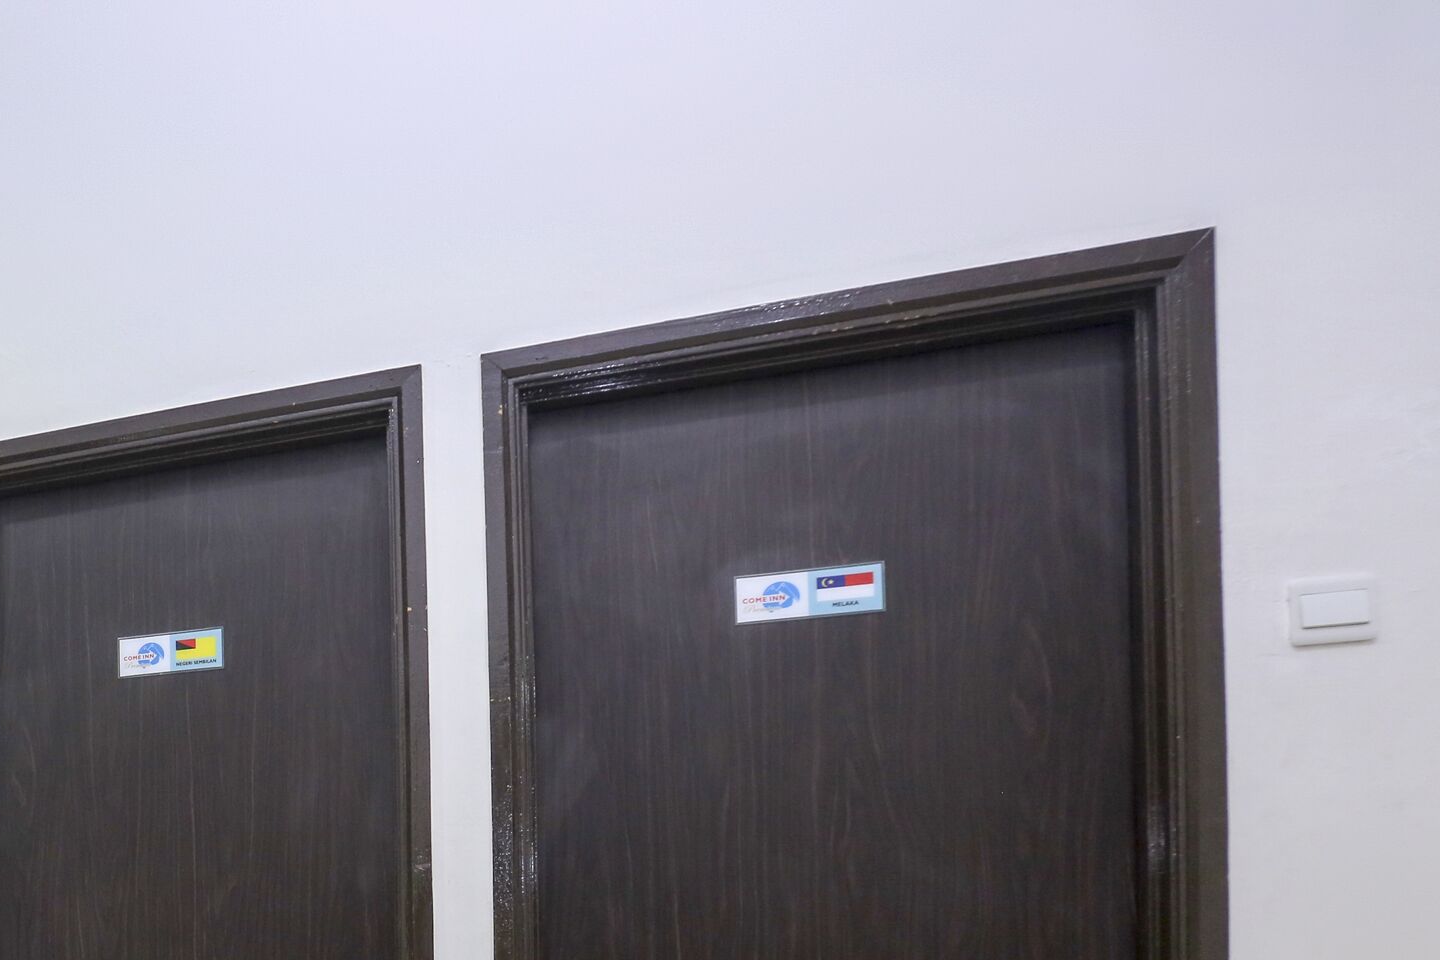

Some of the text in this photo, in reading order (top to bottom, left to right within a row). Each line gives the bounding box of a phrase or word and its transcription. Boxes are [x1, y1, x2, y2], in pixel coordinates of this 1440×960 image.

[742, 595, 767, 605] COME
[832, 600, 859, 608] MELAKA
[123, 653, 141, 662] COME
[194, 658, 217, 666] SEMBILAN
